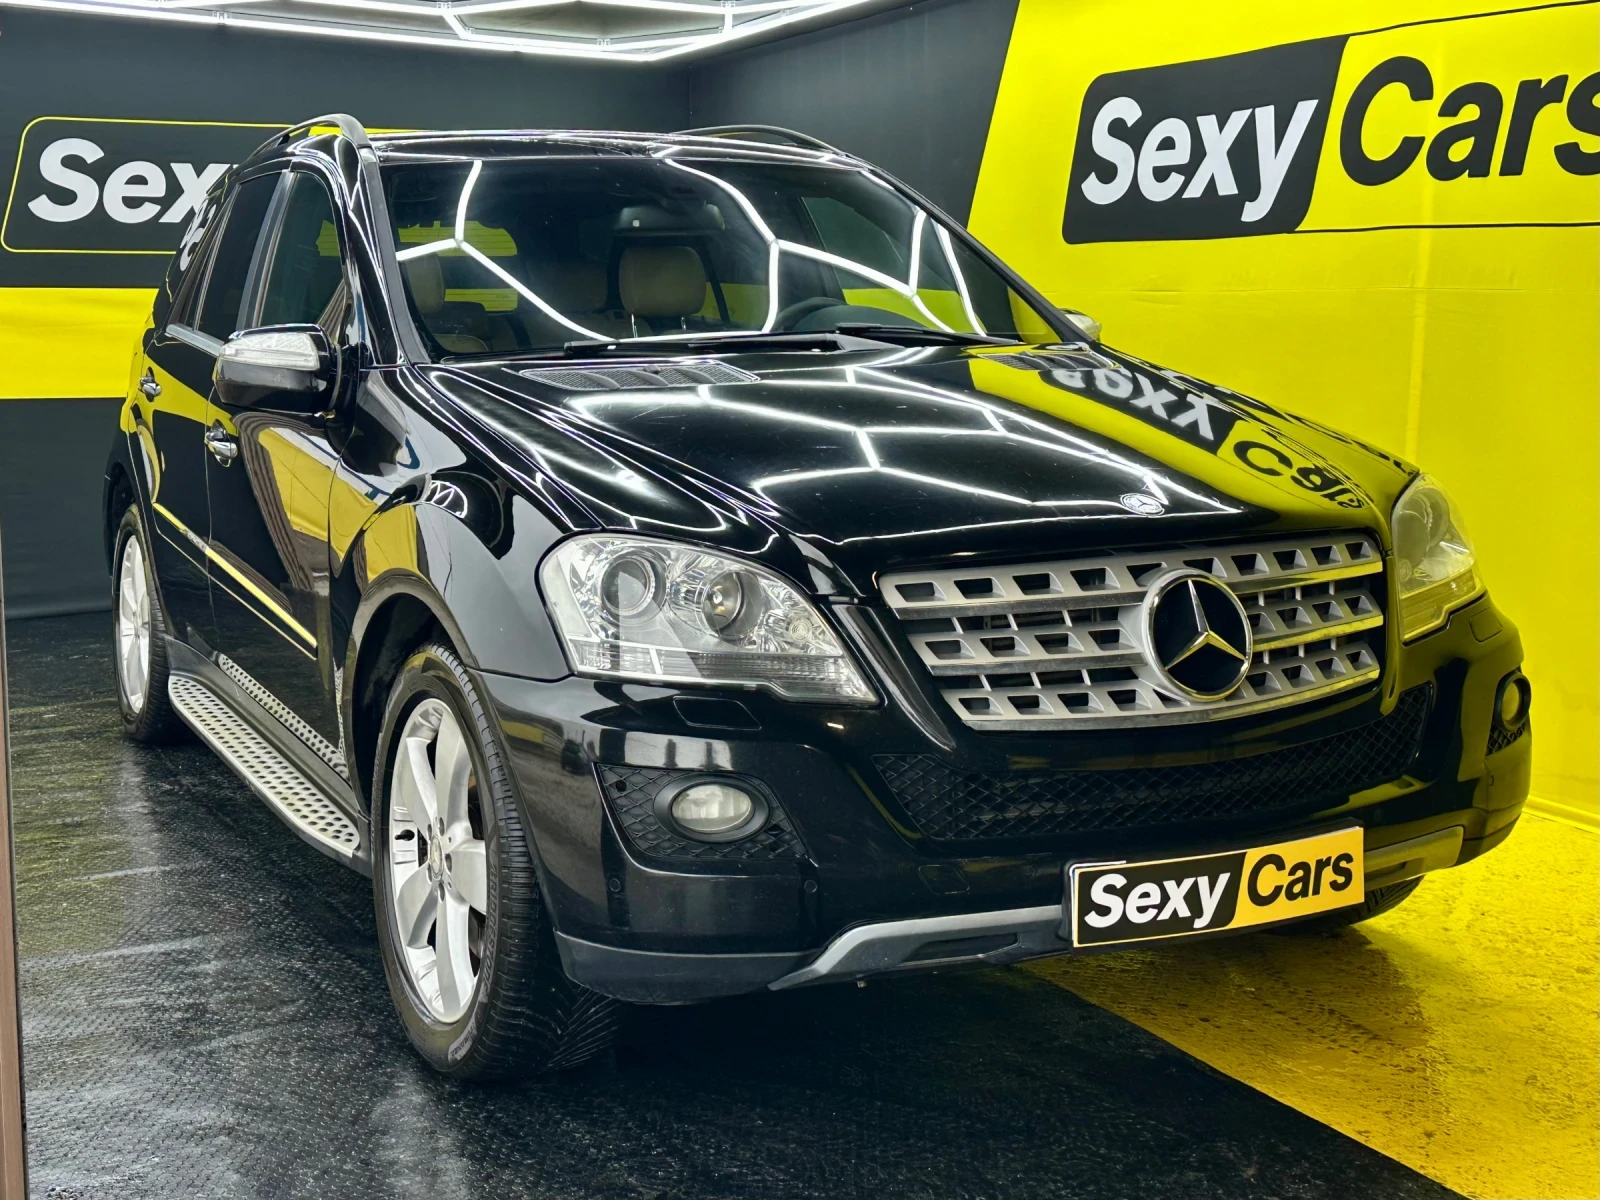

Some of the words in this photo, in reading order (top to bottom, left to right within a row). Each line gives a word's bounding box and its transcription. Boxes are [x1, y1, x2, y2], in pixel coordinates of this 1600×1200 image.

[27, 137, 240, 224] Sex
[1081, 97, 1319, 222] Sexy
[1339, 56, 1600, 187] Cars
[1084, 872, 1231, 929] Sexy
[1246, 852, 1354, 907] Cars
